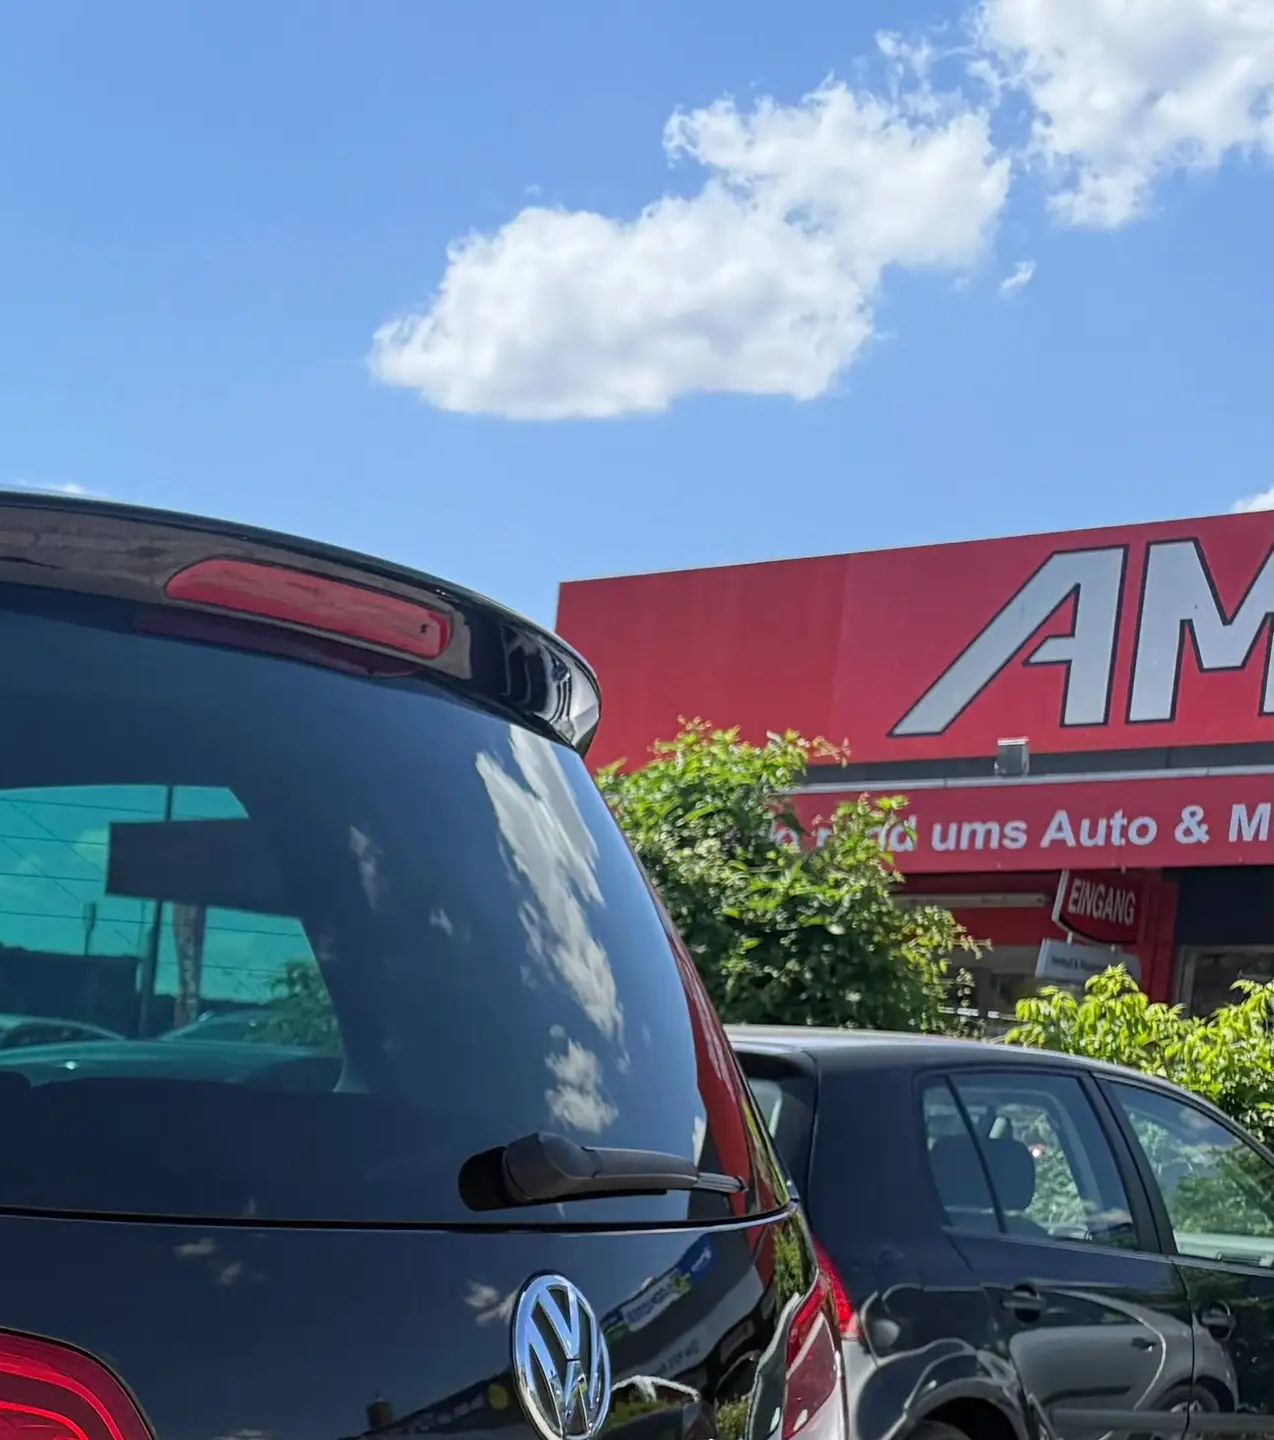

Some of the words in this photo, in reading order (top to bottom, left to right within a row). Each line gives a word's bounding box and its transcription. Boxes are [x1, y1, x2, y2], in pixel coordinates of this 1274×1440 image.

[931, 820, 1028, 851] ums
[1039, 808, 1159, 849] Auto
[1174, 804, 1210, 844] &
[1068, 877, 1136, 926] EINGANG
